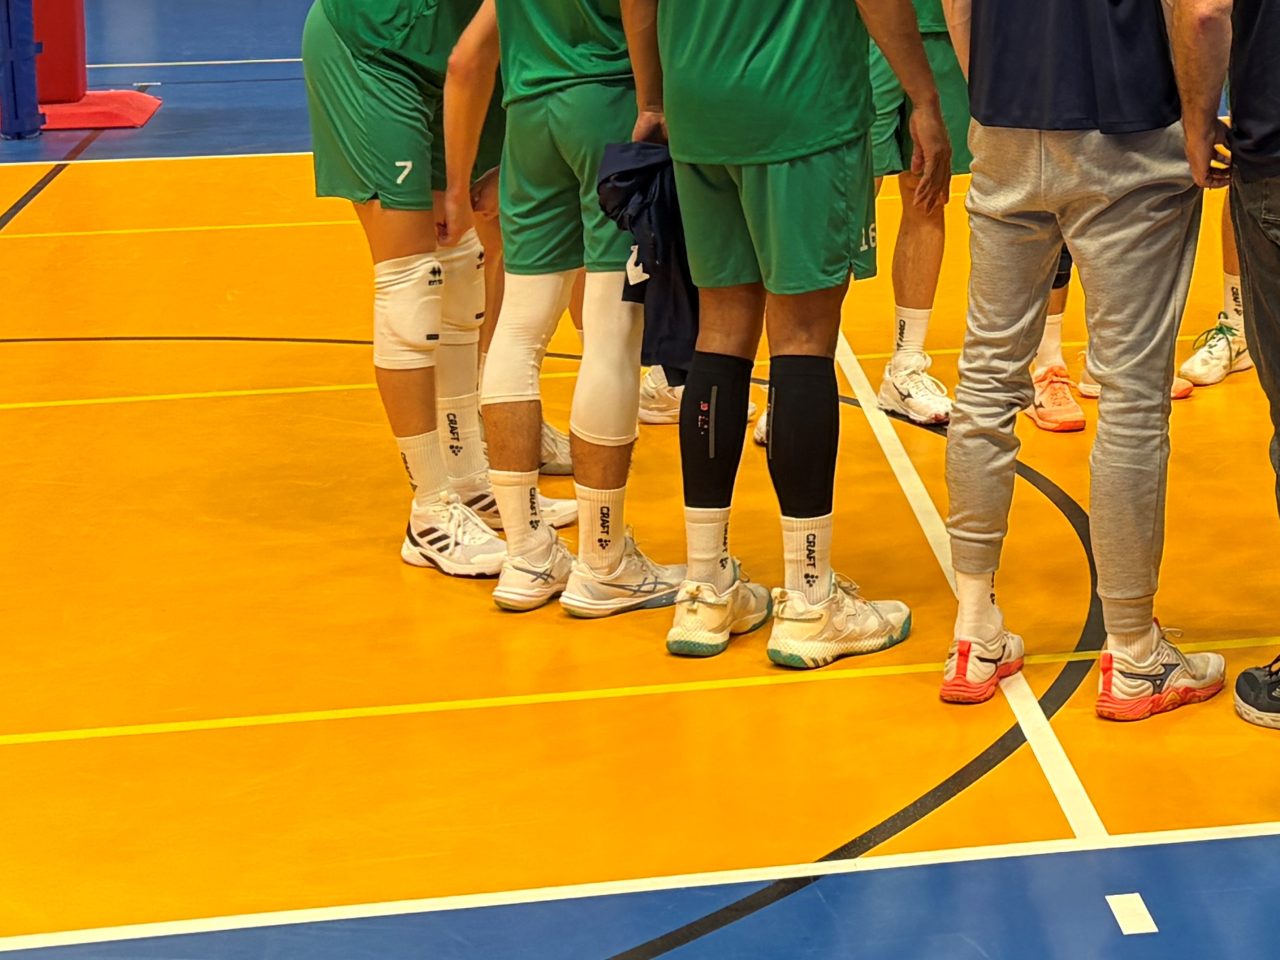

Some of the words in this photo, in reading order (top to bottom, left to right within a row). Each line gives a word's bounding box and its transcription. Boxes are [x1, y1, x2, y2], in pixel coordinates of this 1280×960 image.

[395, 160, 412, 184] 7
[446, 412, 460, 442] CRAFT
[600, 506, 610, 535] CRAFT
[806, 533, 816, 569] CRAFT
